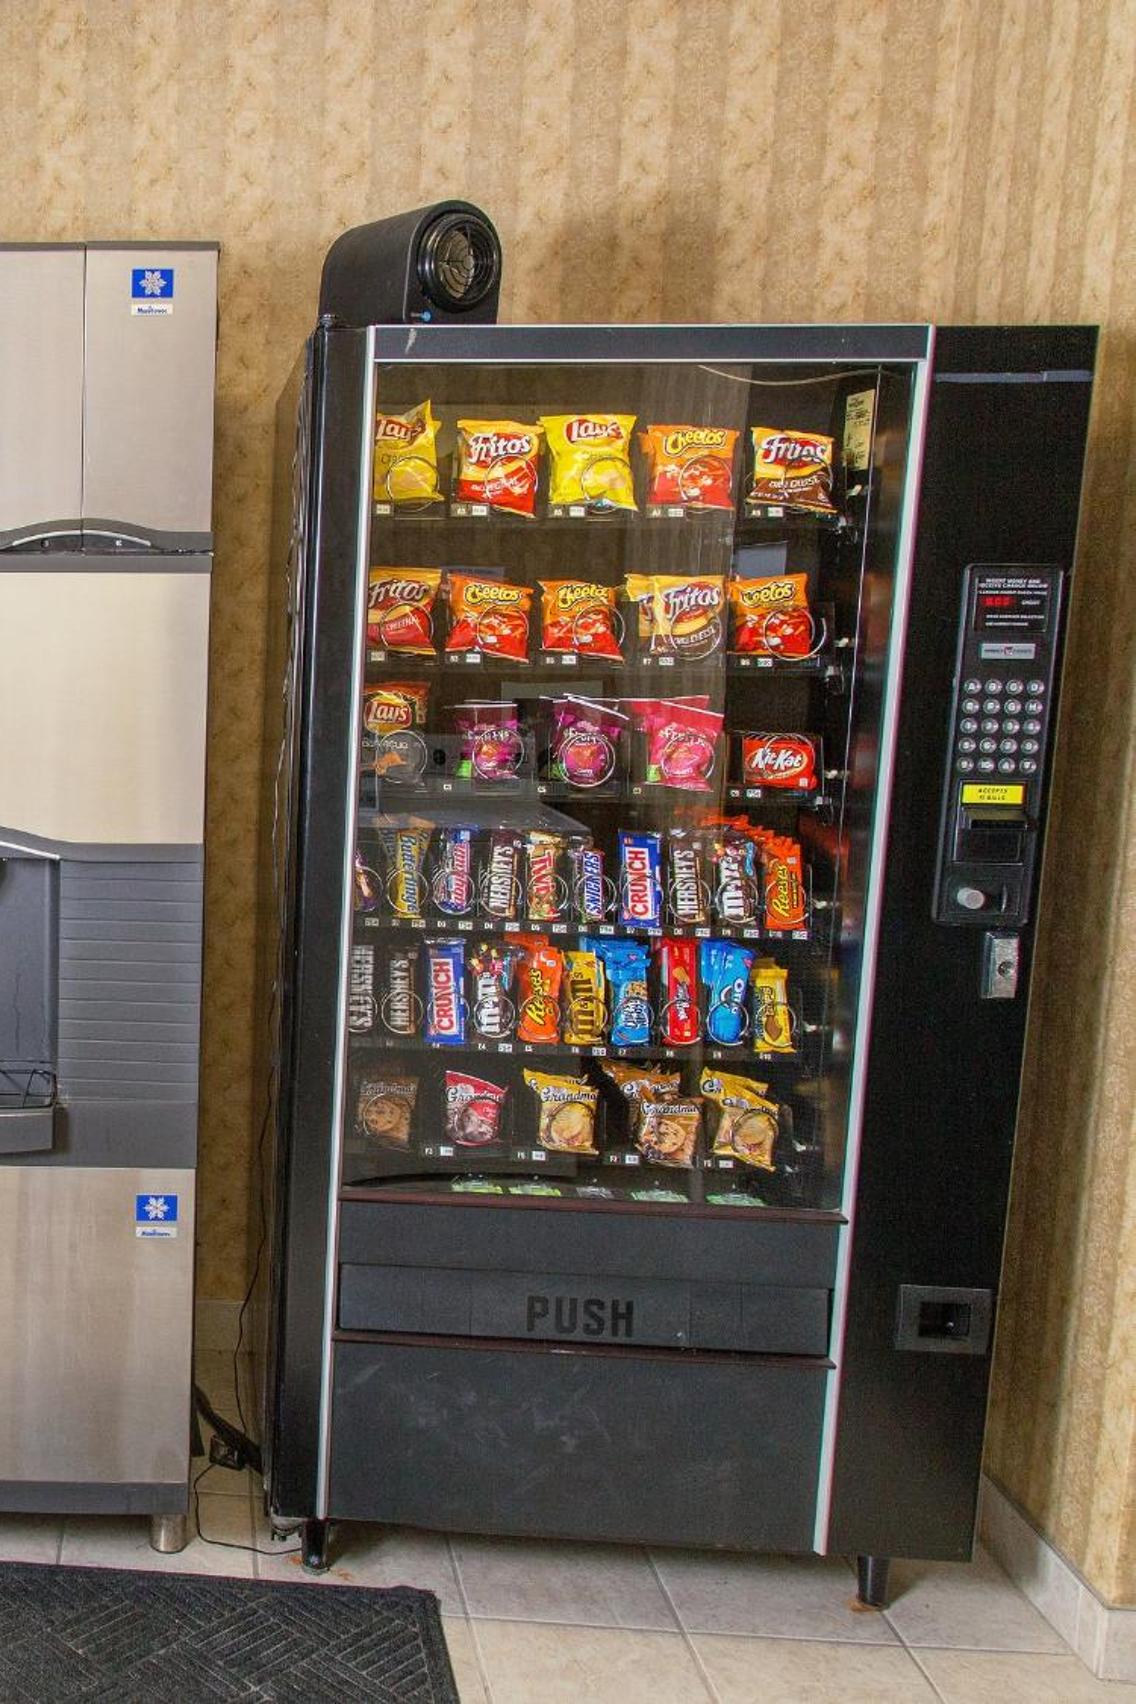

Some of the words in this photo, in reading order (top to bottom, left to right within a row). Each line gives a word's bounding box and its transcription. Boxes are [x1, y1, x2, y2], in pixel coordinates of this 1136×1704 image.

[468, 433, 533, 464] Fritos
[665, 431, 725, 454] Cheetos
[762, 434, 827, 463] Fritos
[368, 578, 430, 608] Fritos
[664, 583, 721, 618] Fritos
[368, 702, 409, 722] Lay's
[584, 850, 601, 916] SNICKERS
[628, 850, 649, 916] CRUNCH
[433, 960, 454, 1031] CRUNCH
[526, 1296, 634, 1338] PUSH
